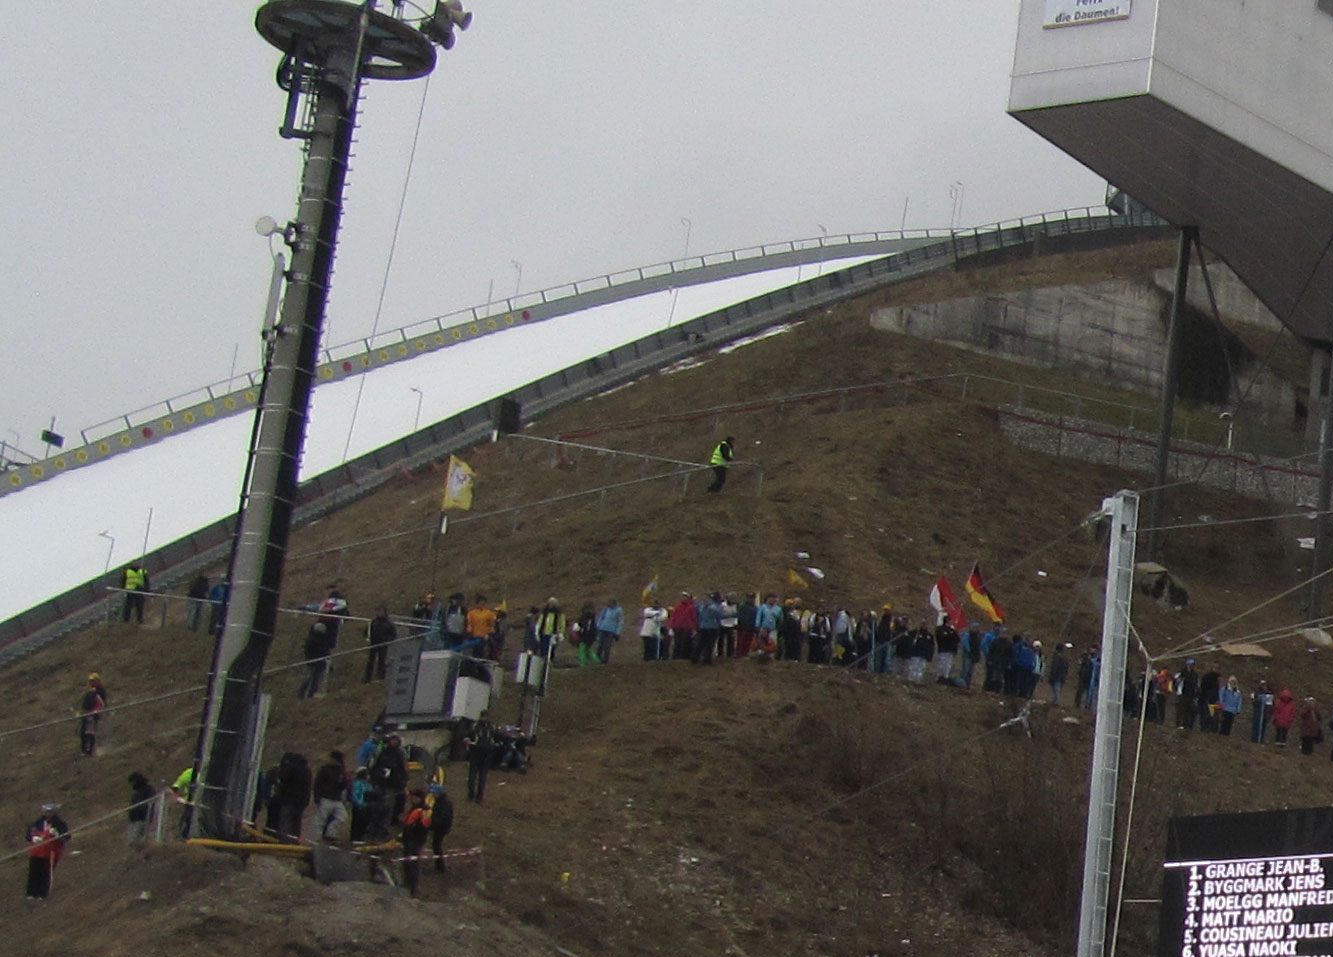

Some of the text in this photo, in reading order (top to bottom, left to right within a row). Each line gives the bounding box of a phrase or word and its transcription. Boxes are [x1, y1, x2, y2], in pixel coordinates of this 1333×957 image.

[1055, 6, 1120, 23] die Daumen!
[1189, 866, 1202, 880] 1.
[1206, 863, 1265, 879] GRANGE
[1266, 859, 1324, 876] JEAN-B.
[1188, 881, 1201, 896] 2.
[1204, 877, 1285, 895] BYGGMARK
[1287, 874, 1325, 890] JENS
[1186, 897, 1200, 911] 3.
[1203, 894, 1263, 911] MOELGG
[1185, 913, 1198, 927] 4.
[1202, 911, 1241, 927] MATT
[1243, 908, 1294, 924] MARIO
[1184, 929, 1197, 943] 5.
[1200, 925, 1284, 943] COUSINEAU
[1249, 940, 1298, 957] NAOKI
